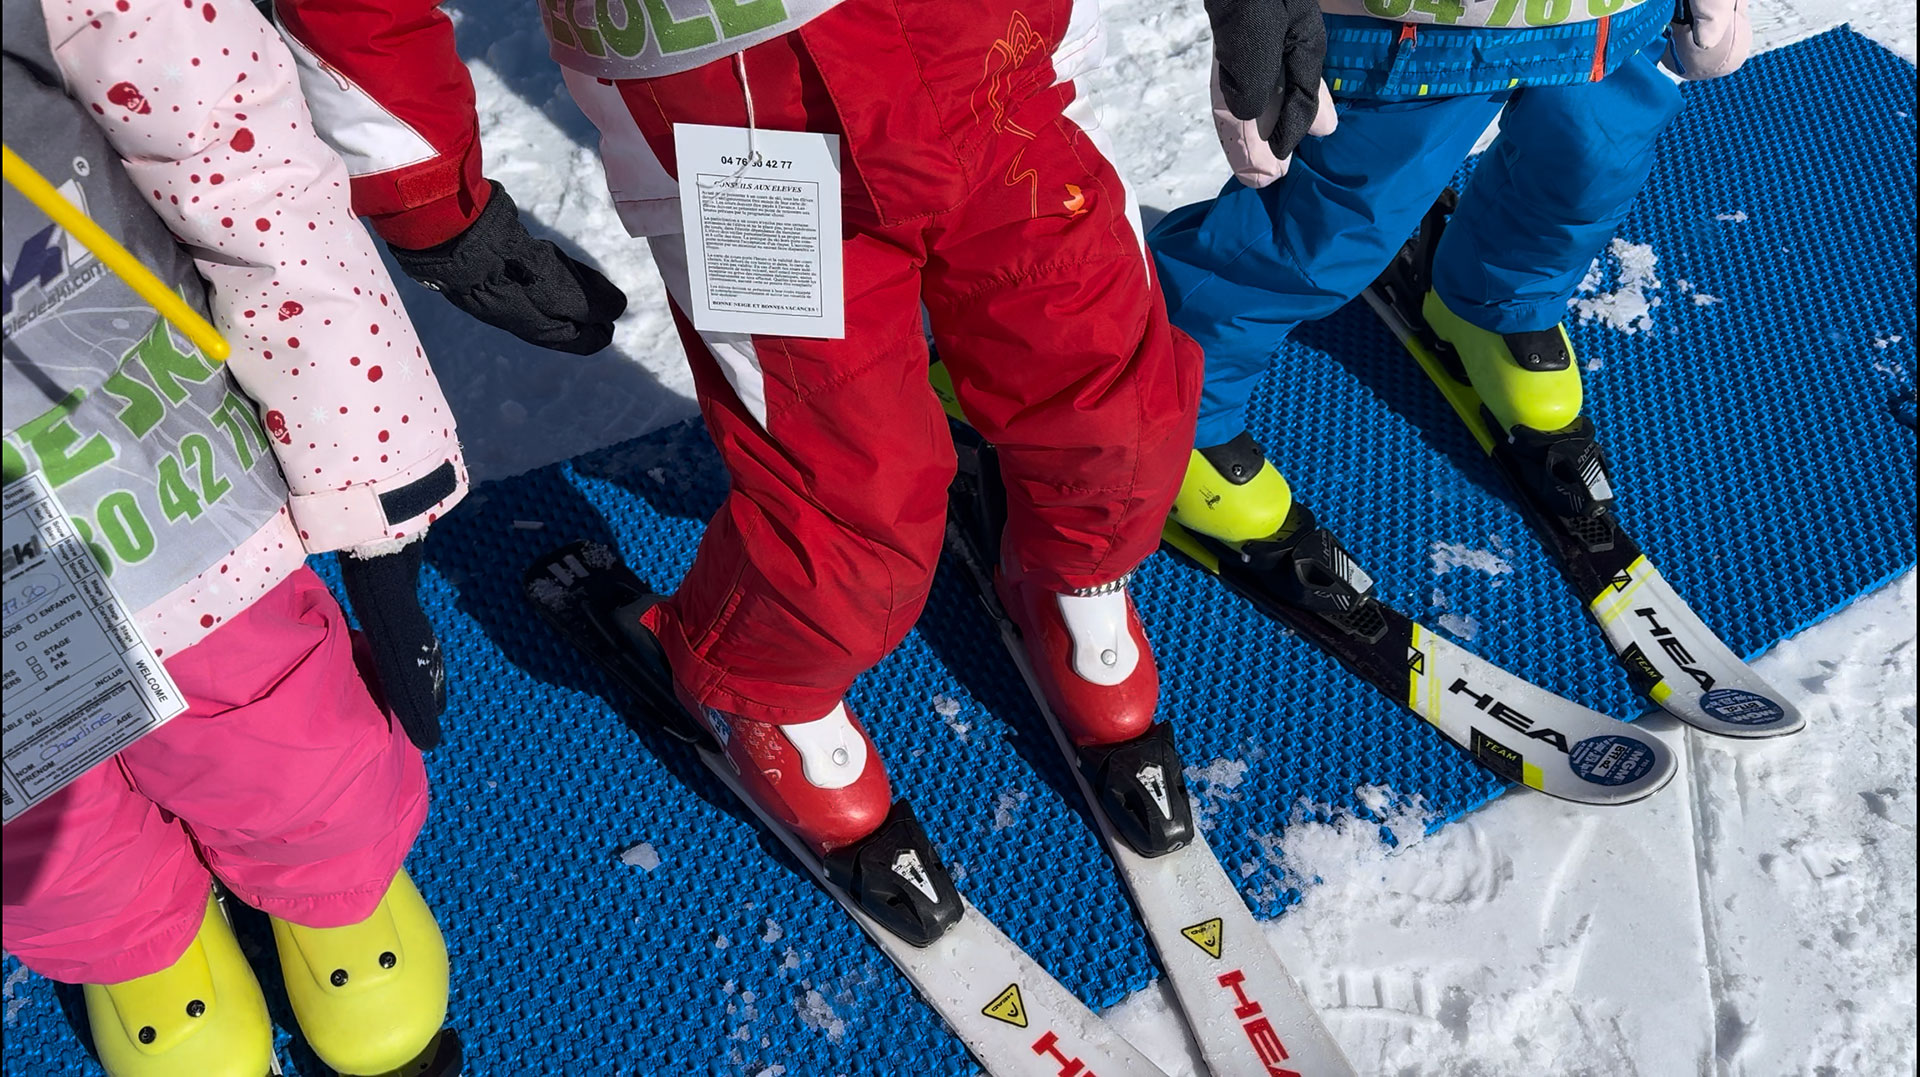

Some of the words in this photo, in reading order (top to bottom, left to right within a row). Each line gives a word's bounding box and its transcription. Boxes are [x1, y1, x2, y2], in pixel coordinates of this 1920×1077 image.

[720, 156, 733, 164] 04
[735, 157, 748, 166] 76
[765, 159, 777, 168] 42
[780, 160, 792, 169] 77
[753, 183, 770, 191] AUX
[156, 432, 233, 527] 42
[39, 592, 76, 617] ENFANTS
[32, 608, 83, 642] COLLECTIFS
[43, 636, 71, 656] STAGE
[48, 649, 67, 664] A.M.
[53, 657, 71, 671] P.M.
[1635, 655, 1658, 679] TEAM
[135, 658, 168, 704] WELCOME
[29, 715, 43, 727] AU
[94, 667, 124, 688] INCLUS
[24, 708, 38, 720] DU
[19, 759, 56, 785] PRENOM
[114, 711, 133, 725] AGE
[1485, 740, 1519, 762] TEAM
[15, 762, 35, 777] NOM
[1612, 746, 1644, 784] MGM
[991, 991, 1014, 1013] HEAD
